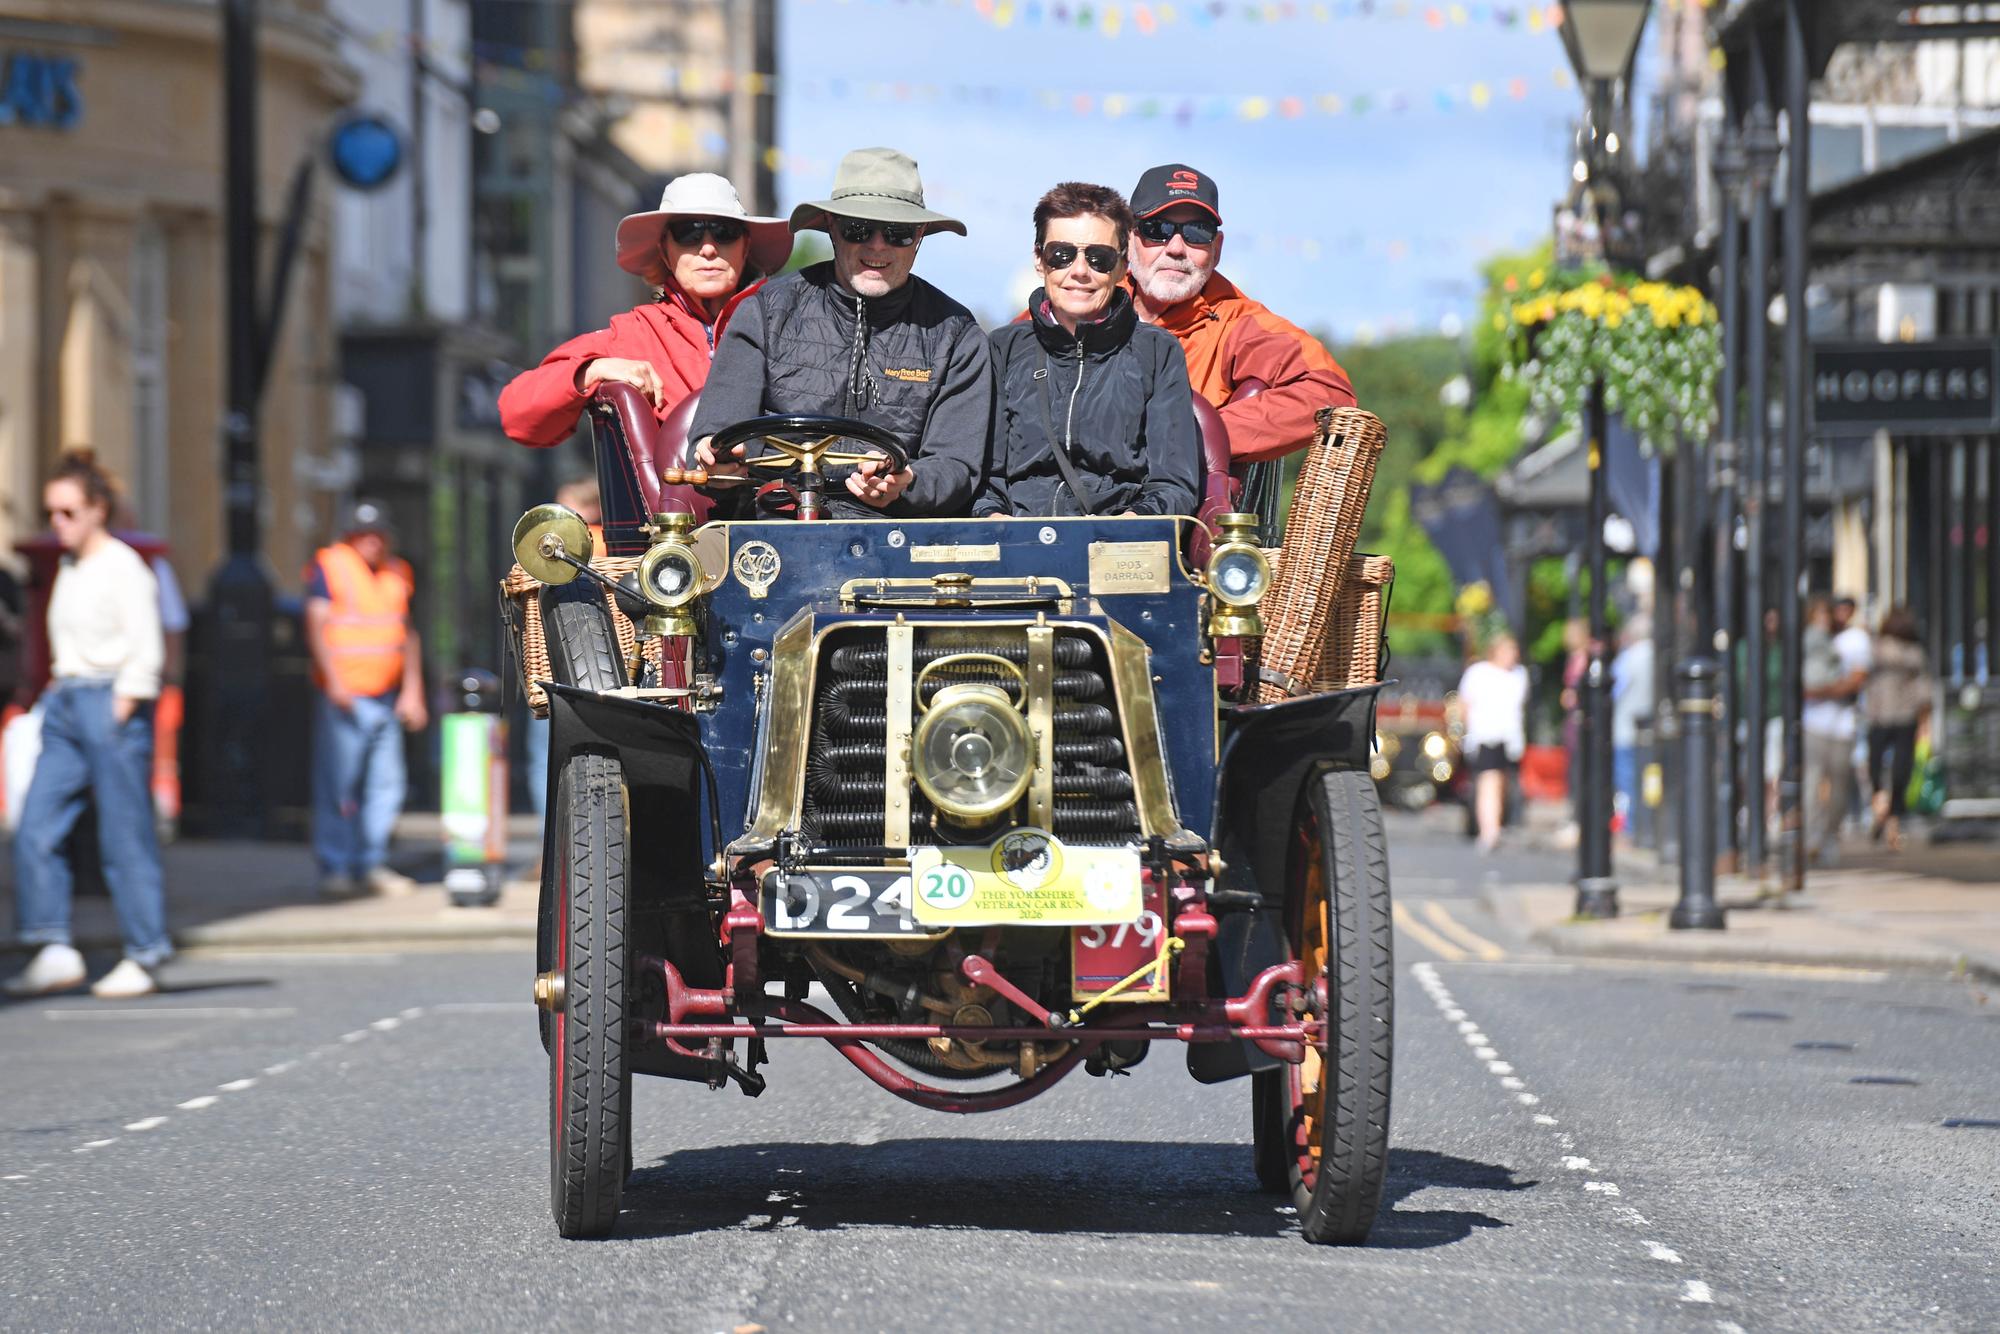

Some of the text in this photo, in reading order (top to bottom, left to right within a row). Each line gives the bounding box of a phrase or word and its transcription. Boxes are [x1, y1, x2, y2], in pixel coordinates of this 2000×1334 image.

[1816, 368, 1988, 402] HOOPERS
[1116, 560, 1142, 570] 1903
[926, 873, 966, 898] 20
[980, 890, 1076, 900] THE YORKSHIRE
[975, 900, 1084, 909] VETERAN CAR RUN
